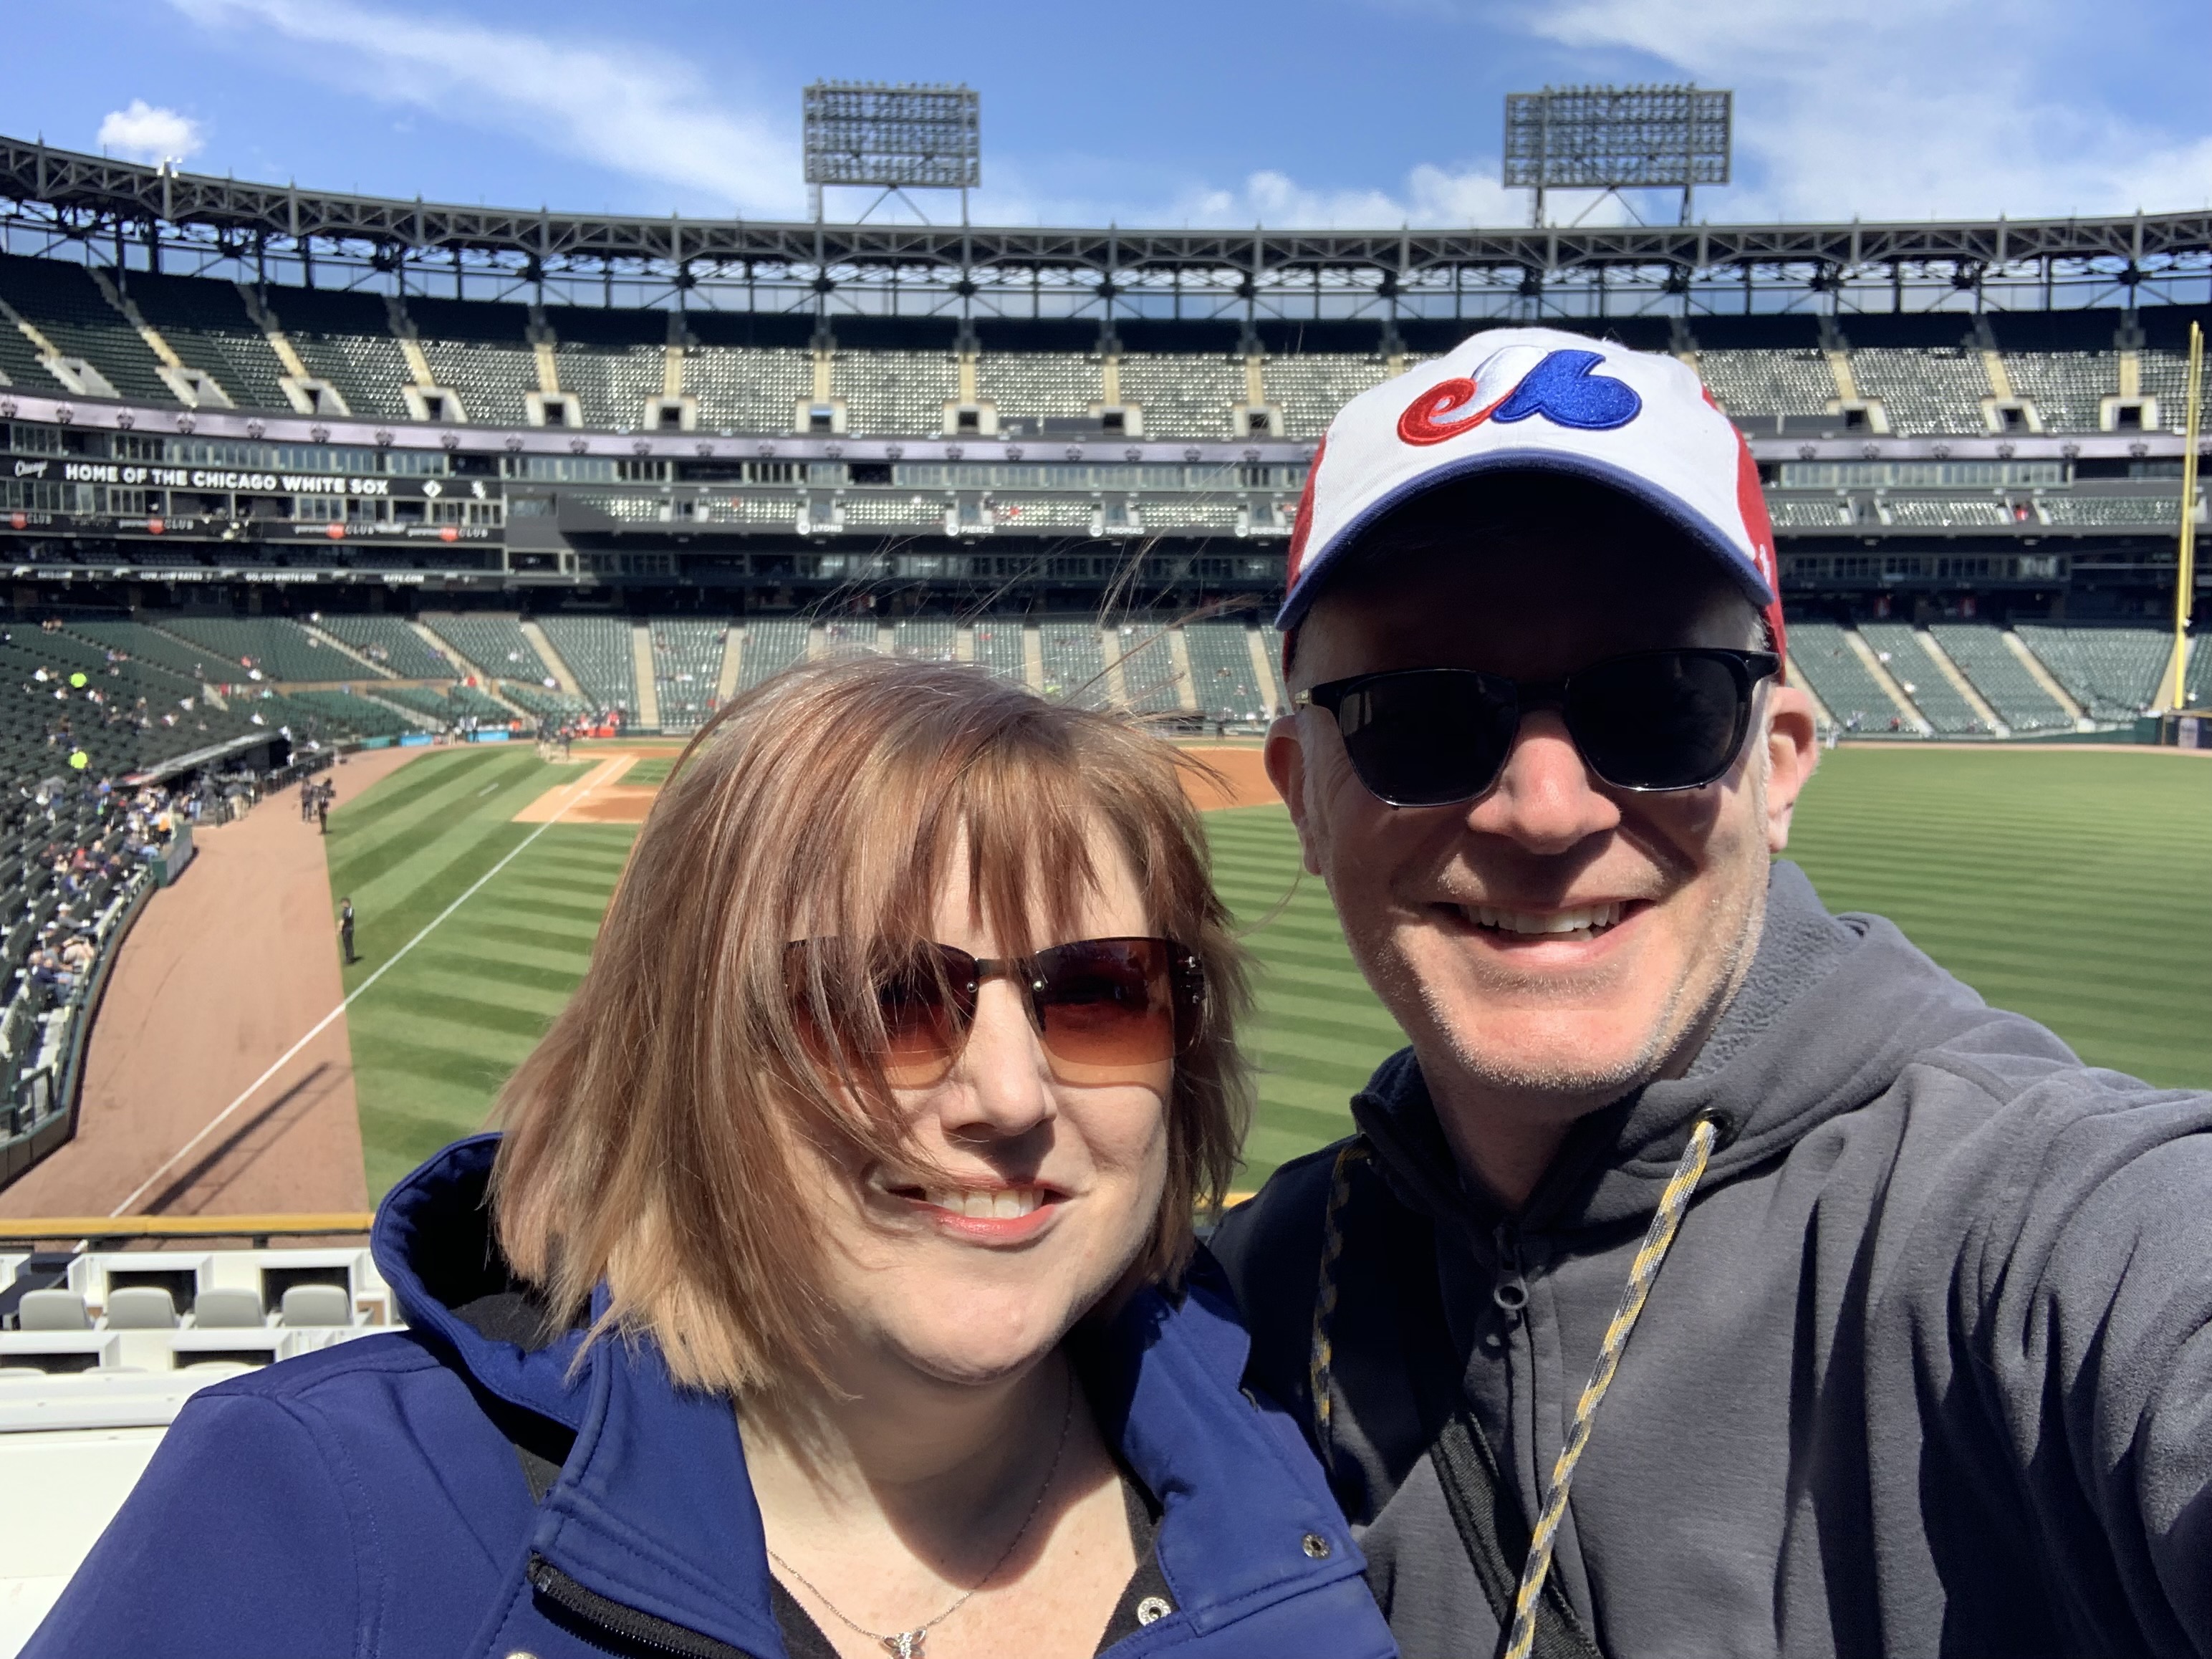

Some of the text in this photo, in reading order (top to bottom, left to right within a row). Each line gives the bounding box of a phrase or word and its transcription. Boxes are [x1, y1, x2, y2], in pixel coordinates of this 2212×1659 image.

[65, 463, 117, 482] HOME
[123, 466, 148, 484] OF
[152, 468, 188, 486] THE
[193, 471, 277, 491] CHICAGO
[282, 475, 347, 494] WHITE
[349, 479, 388, 495] SOX
[163, 518, 195, 530] CLUB
[345, 524, 375, 535] CLUB
[961, 525, 994, 534] PIERCE
[458, 527, 489, 538] CLUB
